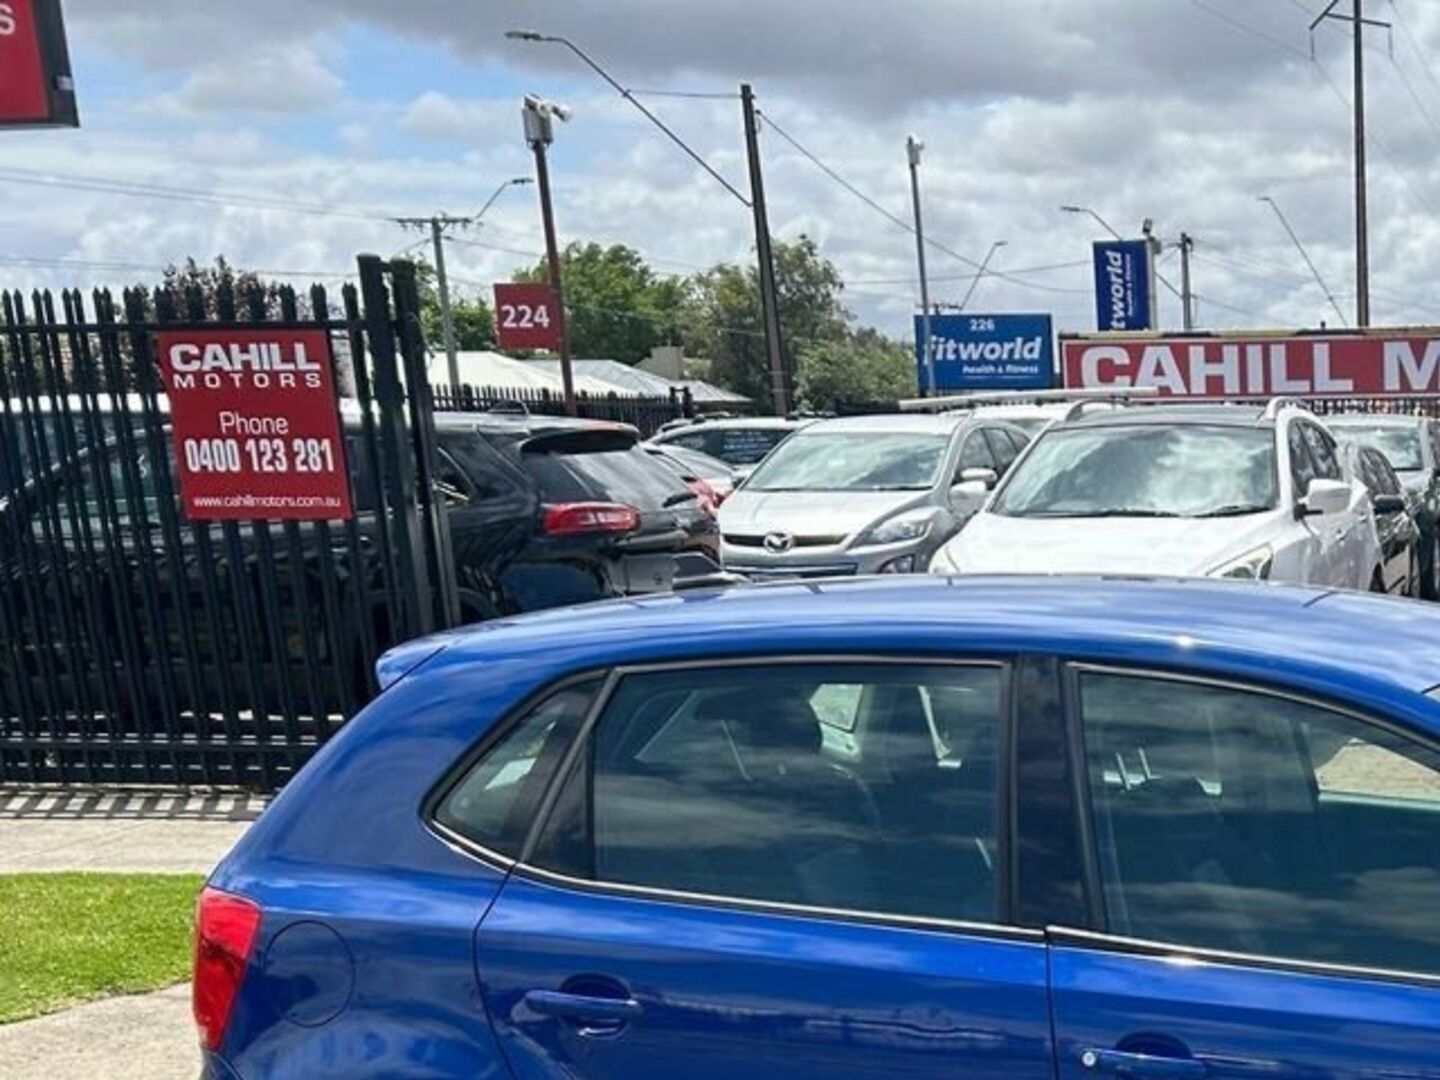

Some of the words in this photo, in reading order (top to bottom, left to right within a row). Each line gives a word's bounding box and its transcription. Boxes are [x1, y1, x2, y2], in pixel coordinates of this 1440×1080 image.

[501, 304, 550, 329] 224
[969, 318, 995, 331] 226
[170, 343, 320, 372] CAHILL
[1081, 343, 1353, 394] CAHILL
[174, 373, 321, 389] MOTORS
[219, 411, 289, 435] Phone
[184, 438, 241, 473] 0400
[245, 438, 288, 473] 123
[293, 438, 334, 473] 281
[193, 495, 341, 507] www.cahillmotors.com.au
